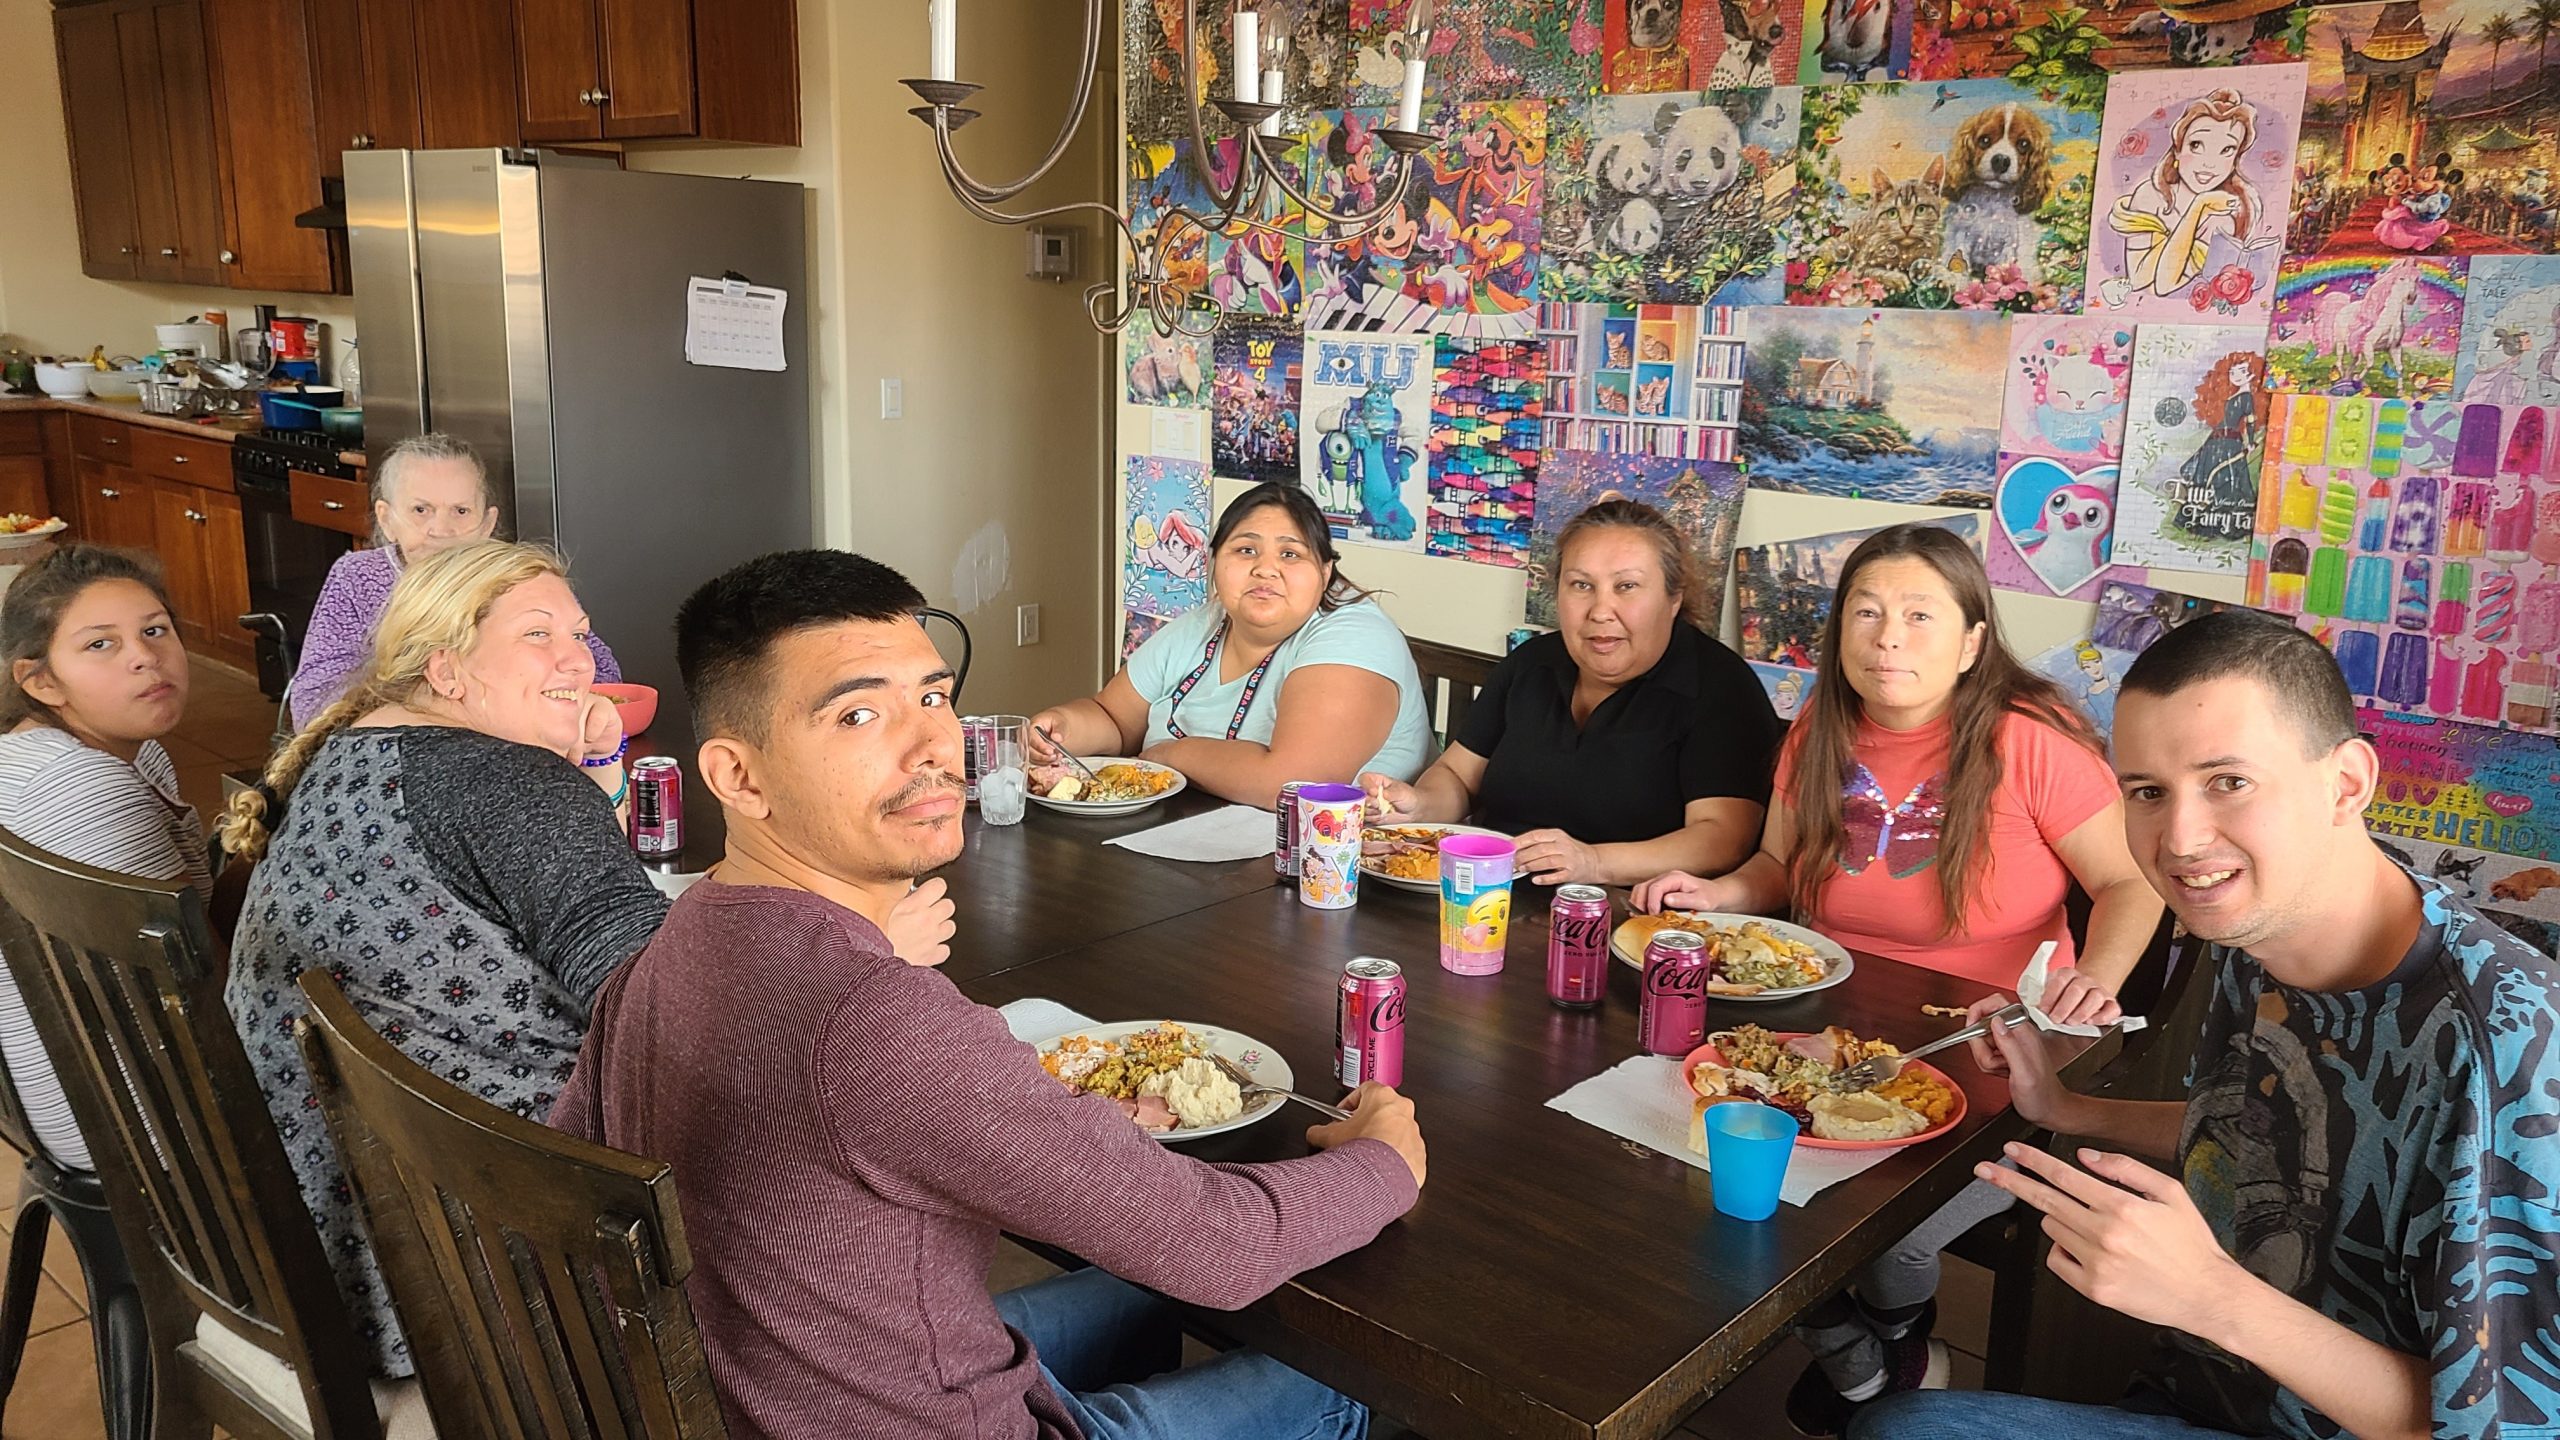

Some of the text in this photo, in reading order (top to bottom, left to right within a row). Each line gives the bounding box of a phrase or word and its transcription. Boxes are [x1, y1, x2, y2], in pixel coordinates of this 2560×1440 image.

[1247, 340, 1276, 358] TOY
[1249, 358, 1273, 366] STORY
[1313, 340, 1420, 391] MU
[1253, 366, 1267, 383] 4
[2181, 504, 2252, 535] Fairy Ta
[1232, 706, 1246, 729] BOLD
[1248, 667, 1264, 688] BOLD
[2433, 810, 2537, 853] HELLO
[1367, 1037, 1376, 1081] CYCLE ME
